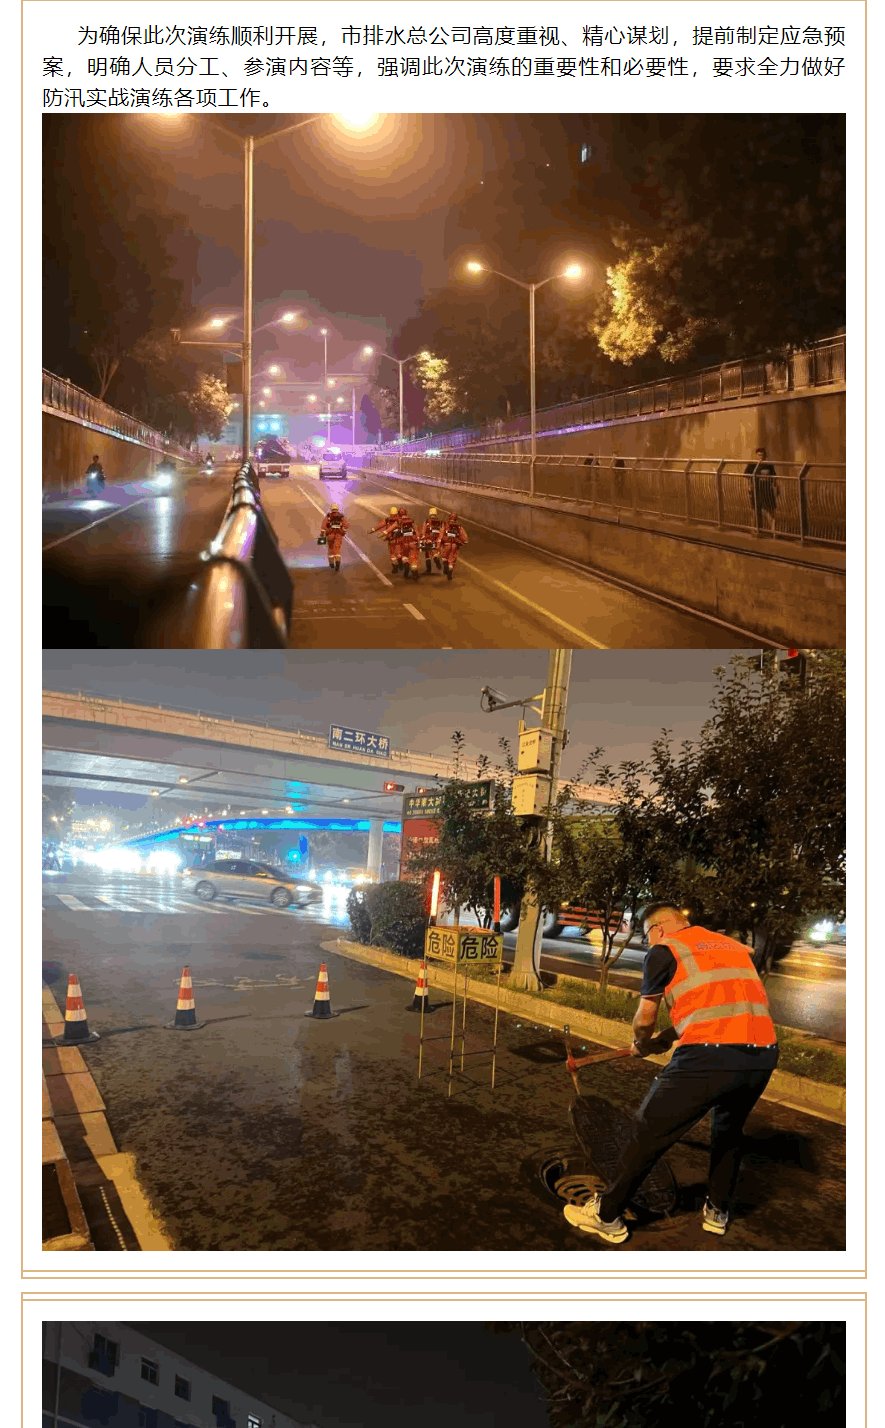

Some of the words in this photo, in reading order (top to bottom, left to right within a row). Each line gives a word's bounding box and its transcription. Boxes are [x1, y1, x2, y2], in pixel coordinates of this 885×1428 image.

[332, 727, 388, 750] 南二环大桥
[428, 931, 455, 958] 危险
[460, 935, 499, 960] 危险
